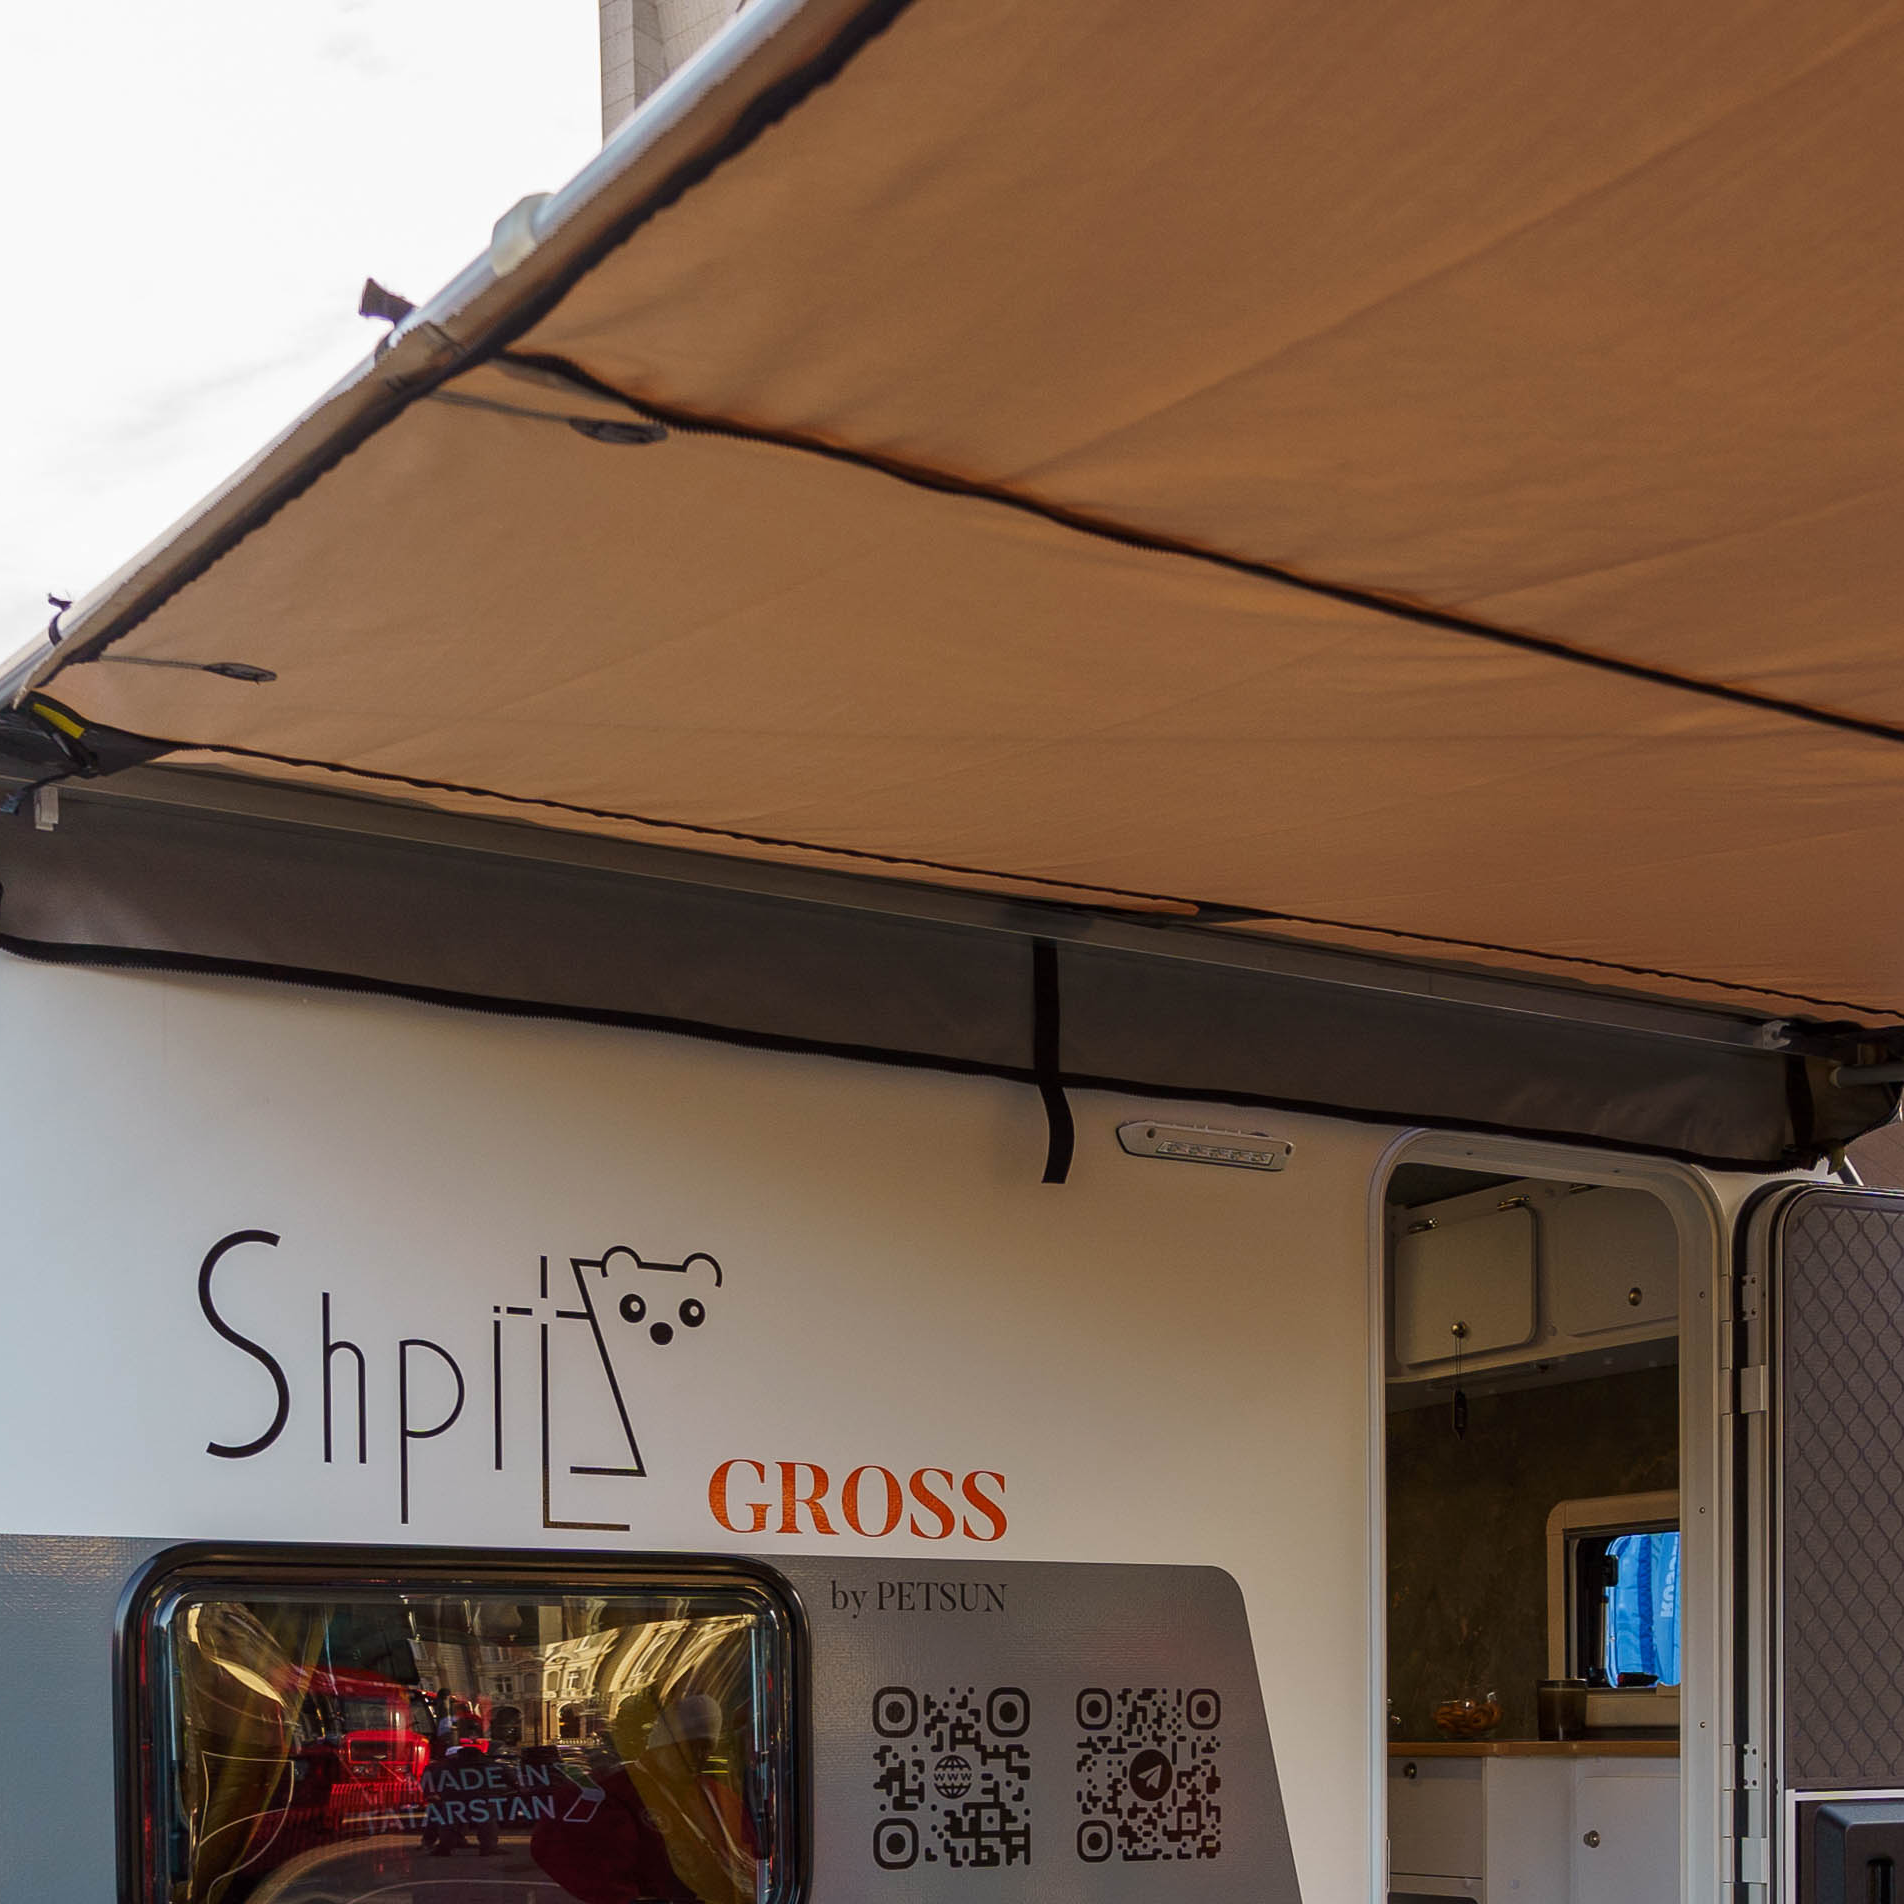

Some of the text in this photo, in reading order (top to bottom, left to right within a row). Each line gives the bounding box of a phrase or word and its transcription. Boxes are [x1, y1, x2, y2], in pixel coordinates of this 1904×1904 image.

[708, 1459, 1008, 1541] GROSS
[831, 1580, 1008, 1618] by PETSUN
[409, 1764, 551, 1797] MADE IN
[361, 1794, 556, 1835] TATARSTAN
